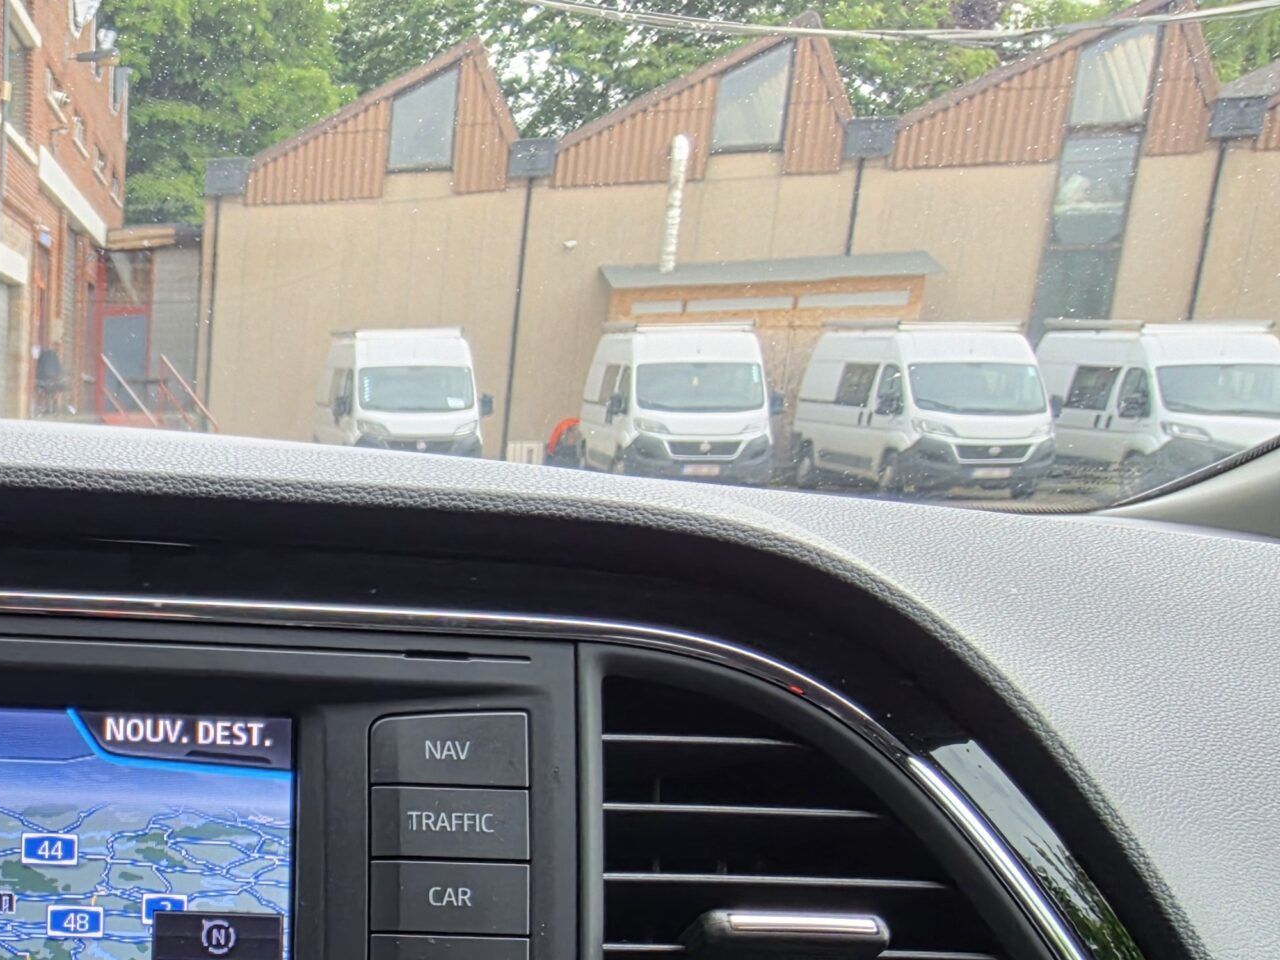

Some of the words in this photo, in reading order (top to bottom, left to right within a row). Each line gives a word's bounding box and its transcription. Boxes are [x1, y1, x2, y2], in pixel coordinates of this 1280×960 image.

[104, 716, 188, 743] NOUV.
[197, 721, 273, 748] DEST.
[425, 740, 470, 760] NAV
[408, 811, 496, 833] TRAFFIC
[37, 840, 64, 860] 44
[428, 886, 472, 906] CAR
[63, 912, 90, 932] 48
